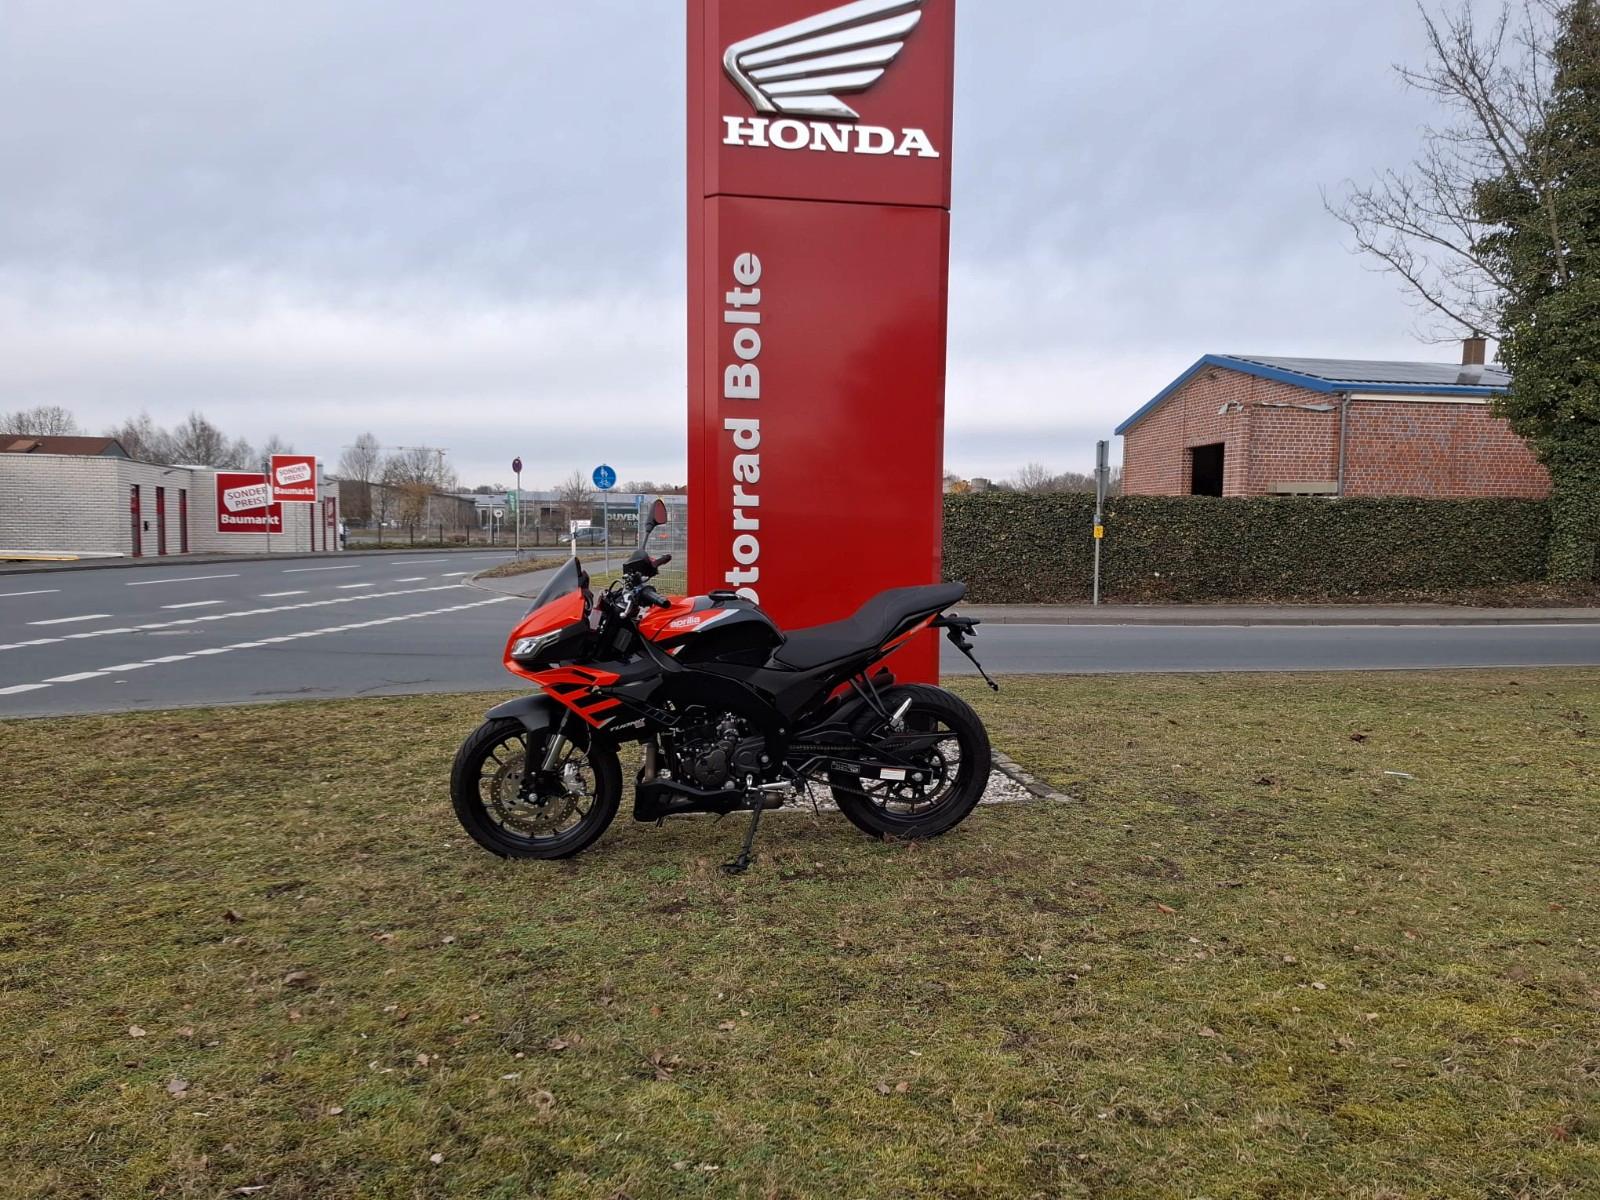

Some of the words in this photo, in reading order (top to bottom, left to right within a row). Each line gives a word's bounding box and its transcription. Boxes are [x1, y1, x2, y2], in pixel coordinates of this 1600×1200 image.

[722, 115, 940, 158] HONDA
[724, 252, 762, 399] Bolte
[278, 465, 307, 477] SONDER
[227, 487, 268, 500] SONDER
[274, 487, 314, 495] Baumarkt
[670, 616, 701, 629] aprilia
